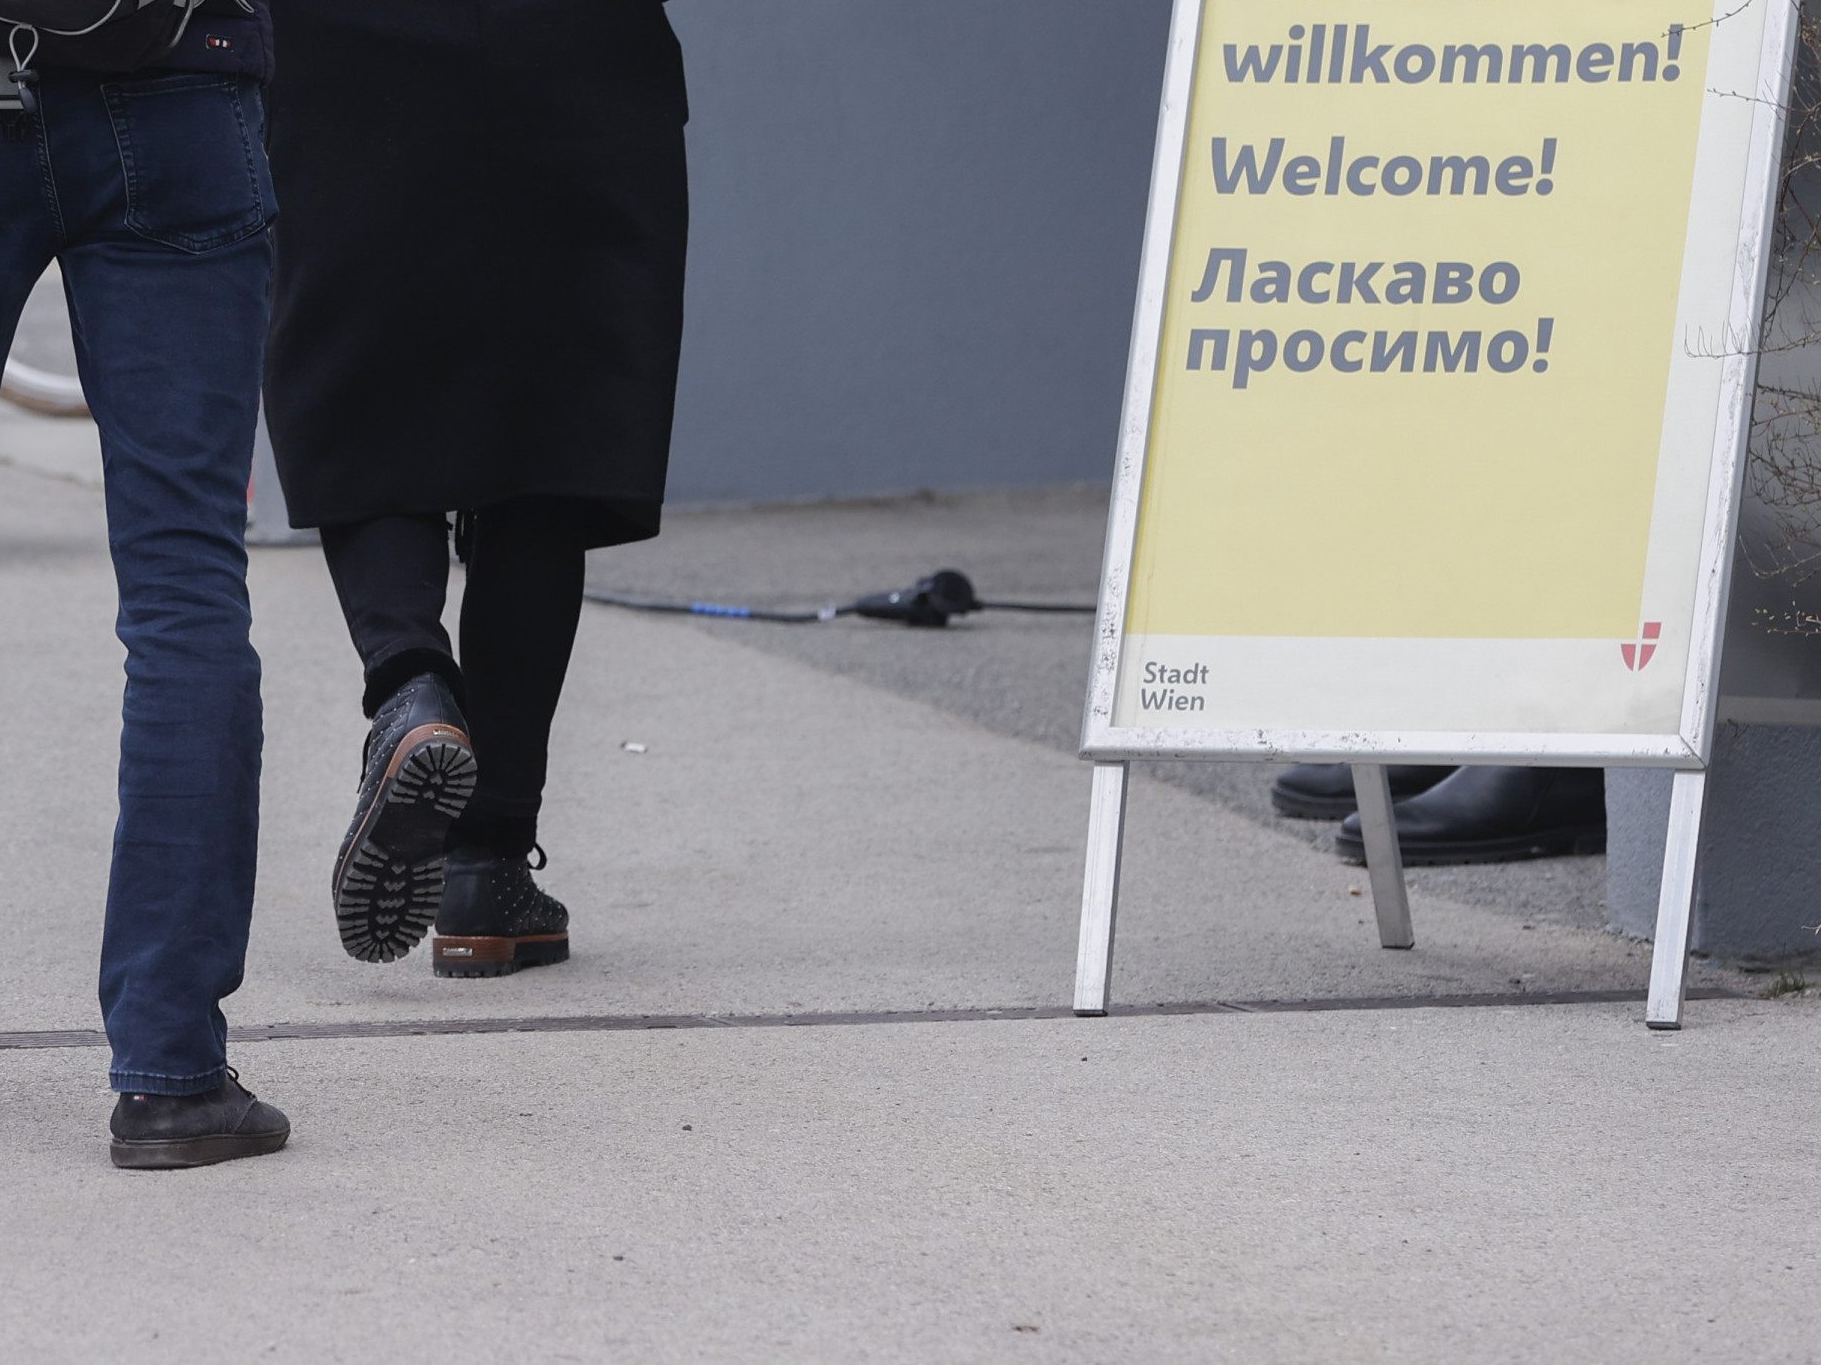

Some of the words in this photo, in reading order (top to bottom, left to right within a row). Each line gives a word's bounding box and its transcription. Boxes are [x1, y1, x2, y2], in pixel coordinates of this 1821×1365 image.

[1223, 23, 1684, 84] willkommen!
[1211, 136, 1558, 197] Welcome!
[1190, 247, 1521, 305] Ласкаво
[1185, 317, 1555, 390] просимо!
[1140, 688, 1205, 711] Wien
[1142, 661, 1209, 685] Stadt
